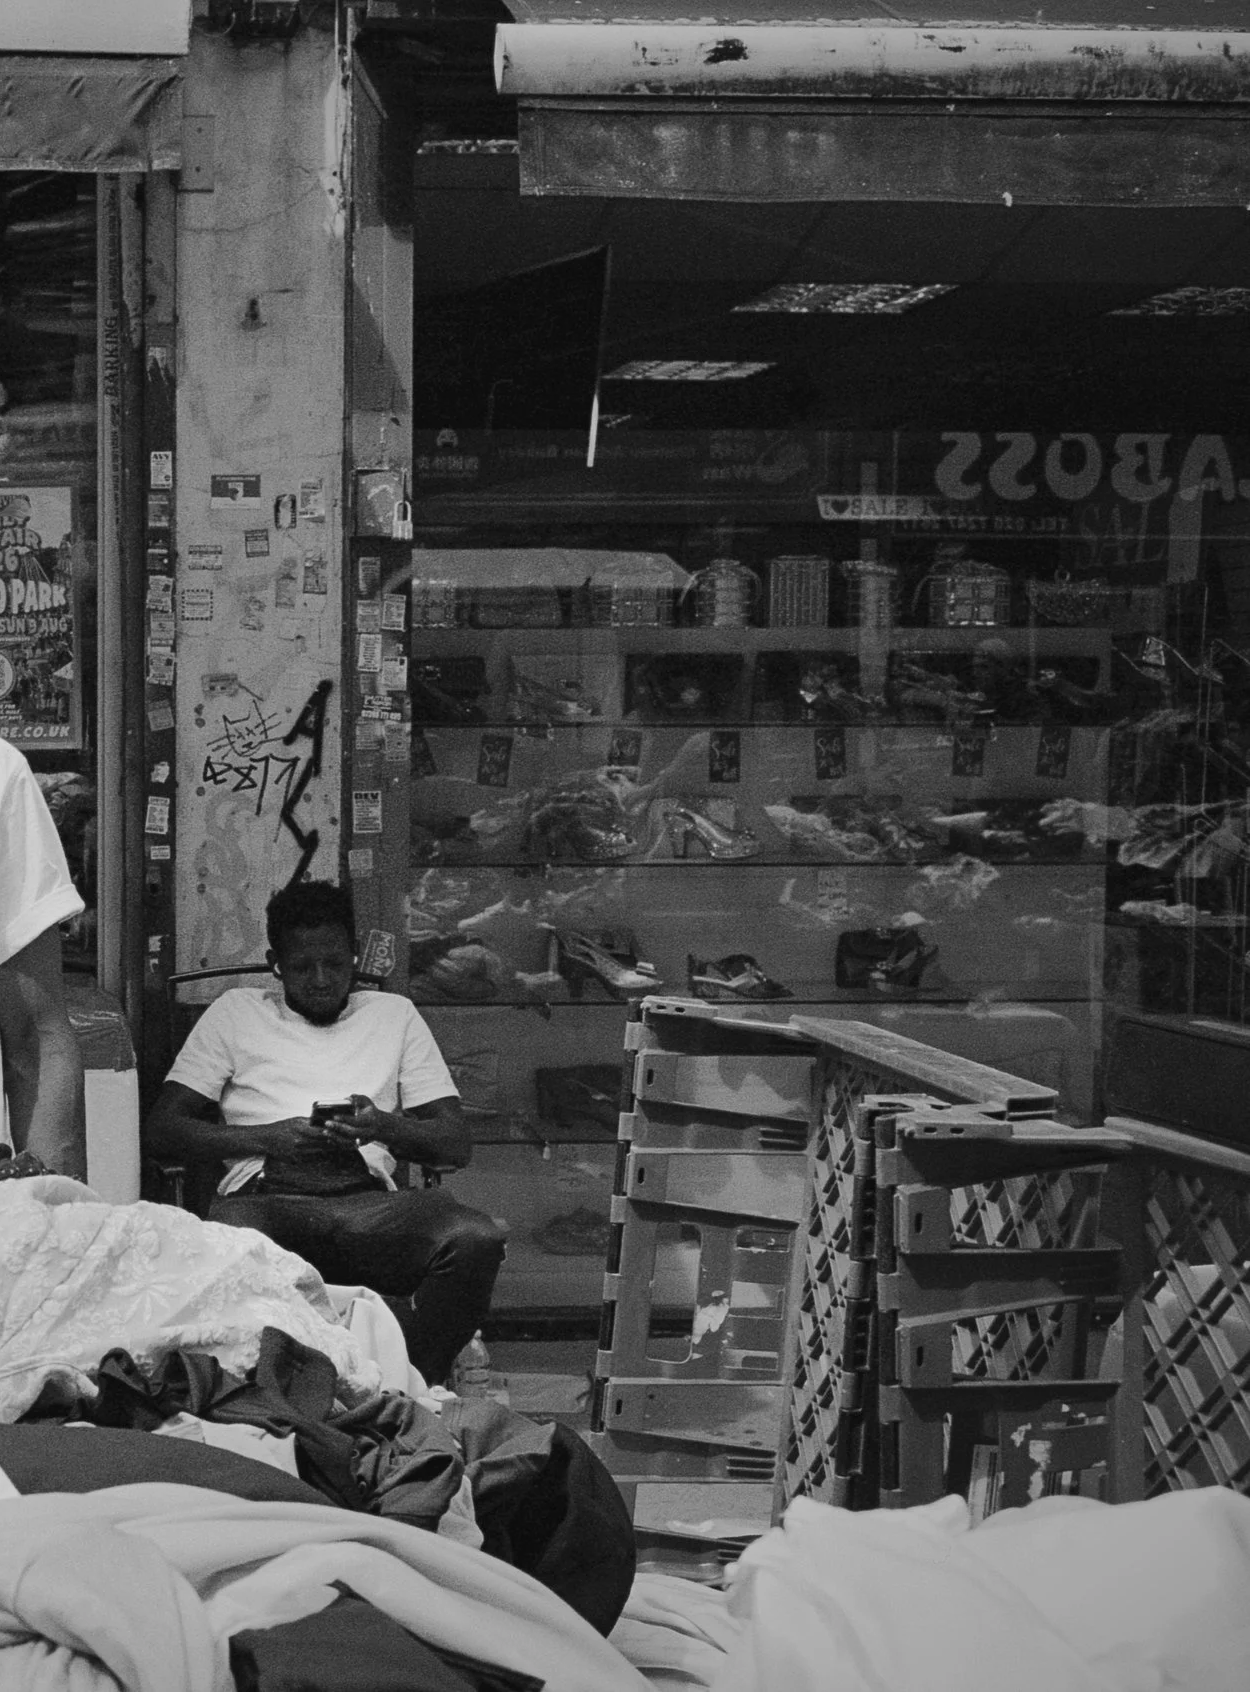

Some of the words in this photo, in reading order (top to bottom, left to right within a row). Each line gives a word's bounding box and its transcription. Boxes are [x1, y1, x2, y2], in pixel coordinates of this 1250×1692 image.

[104, 314, 119, 398] BARKING
[850, 498, 908, 515] SALE
[11, 579, 67, 615] PARK
[38, 616, 69, 634] AUG
